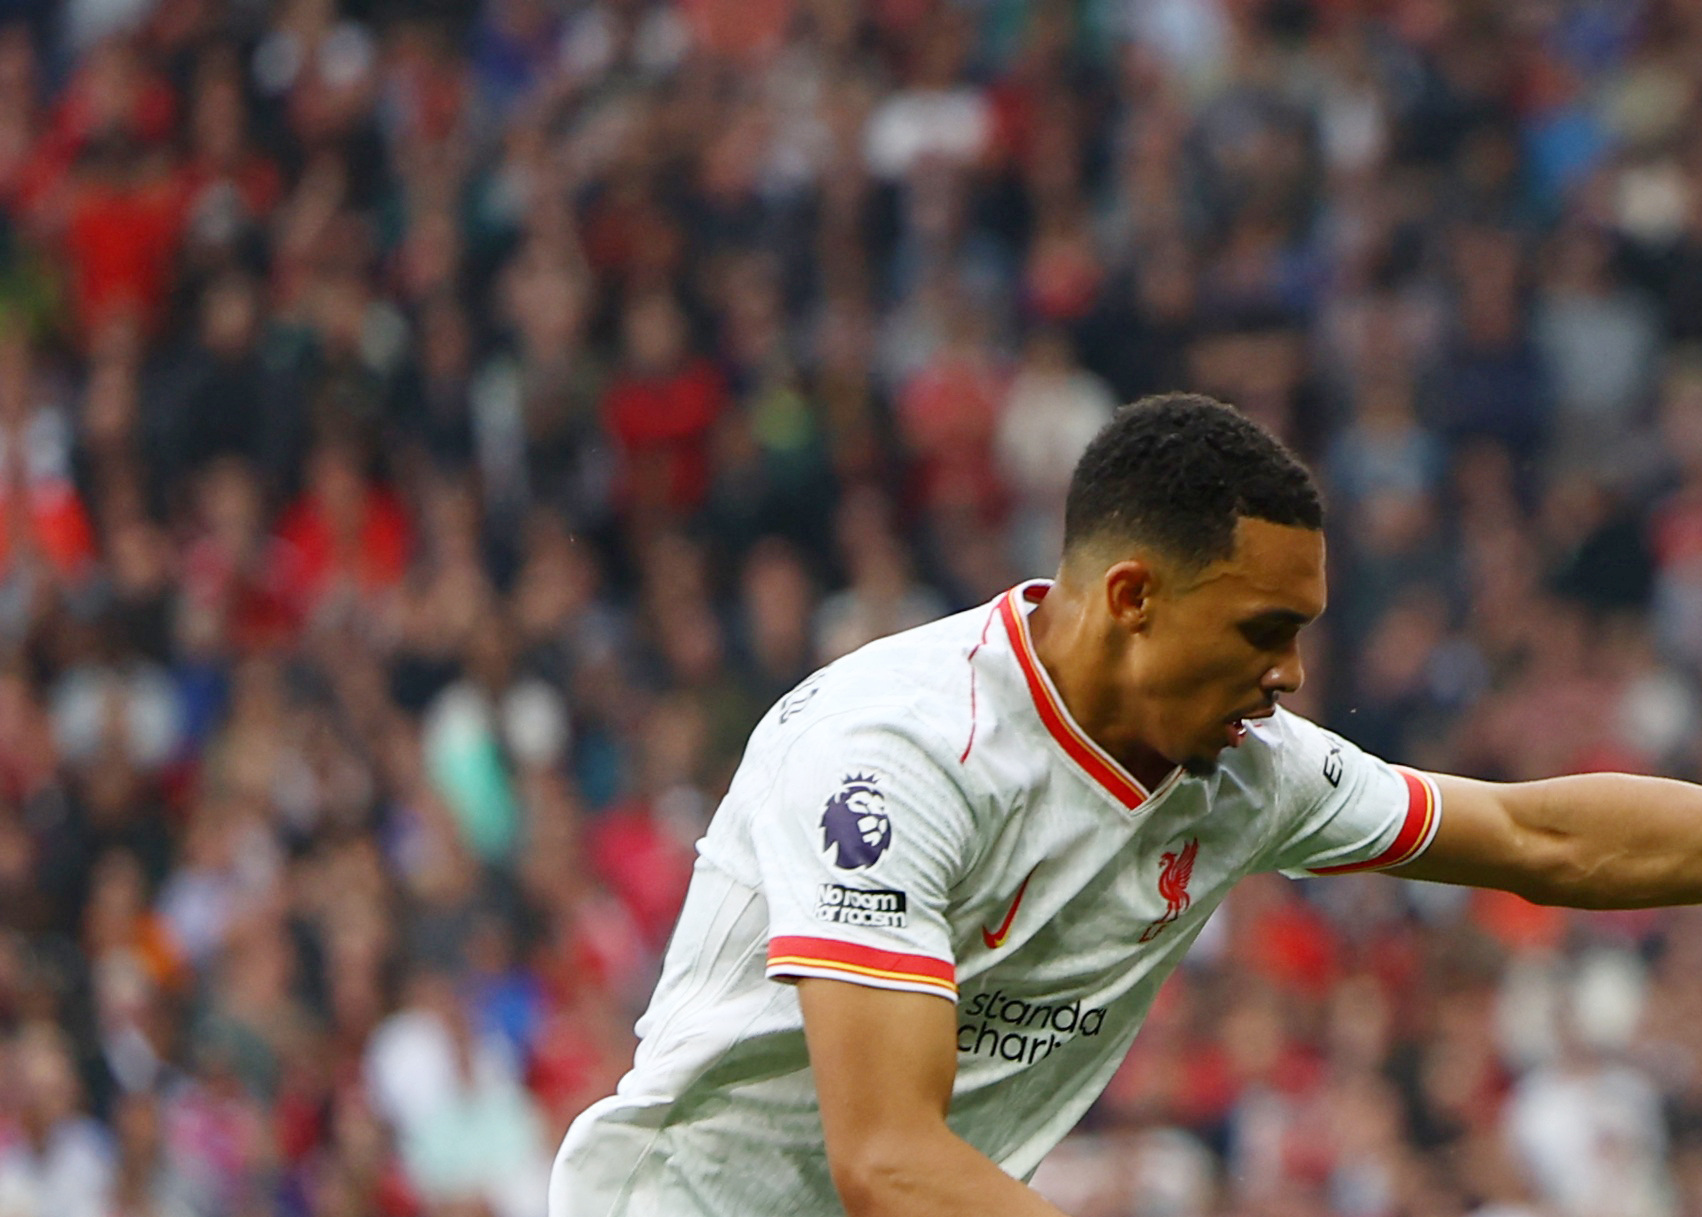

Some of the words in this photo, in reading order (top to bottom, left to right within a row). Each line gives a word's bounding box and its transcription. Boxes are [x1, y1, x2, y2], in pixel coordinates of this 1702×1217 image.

[819, 884, 844, 905] No
[843, 889, 898, 911] room
[839, 906, 907, 928] racism
